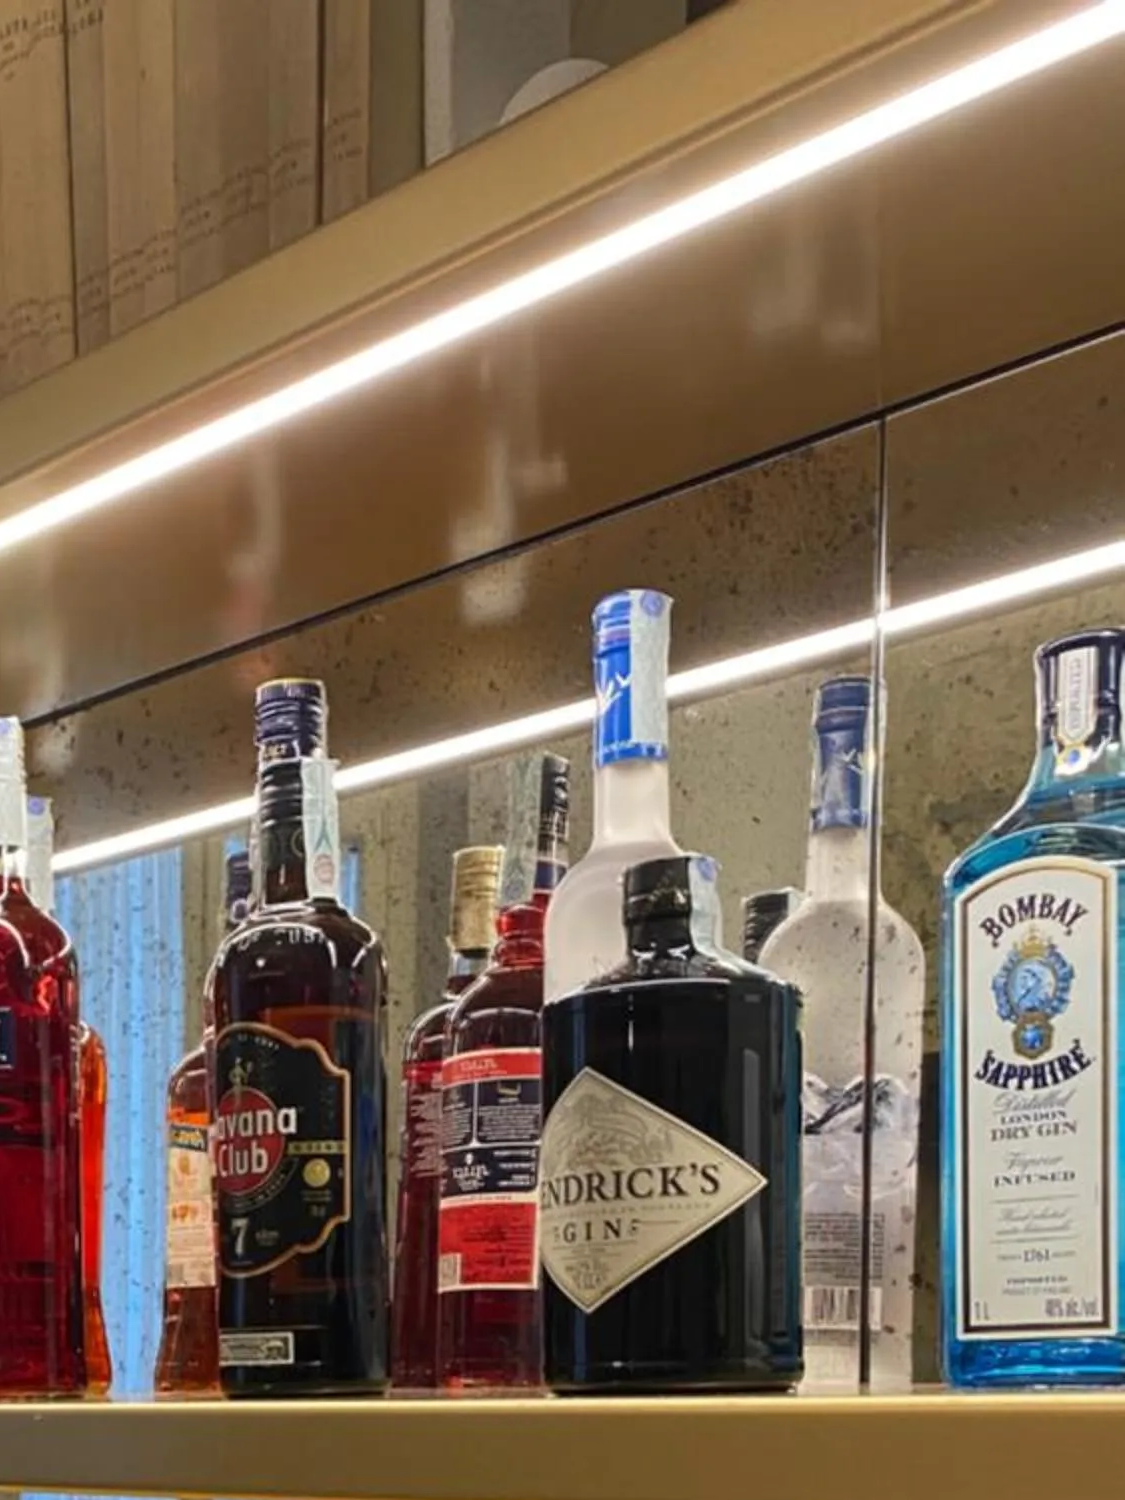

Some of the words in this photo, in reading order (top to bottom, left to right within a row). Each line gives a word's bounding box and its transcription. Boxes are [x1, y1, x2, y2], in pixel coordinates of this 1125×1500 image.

[979, 892, 1089, 949] BOMBAY
[974, 1038, 1092, 1091] SAPPHIRE
[216, 1105, 298, 1139] avana
[990, 1125, 1033, 1143] DRY
[1036, 1120, 1079, 1138] GIN
[1000, 1109, 1068, 1126] LONDON
[218, 1140, 269, 1179] Club
[992, 1170, 1076, 1189] INFUSED
[231, 1217, 250, 1257] 7
[562, 1218, 622, 1244] GIN
